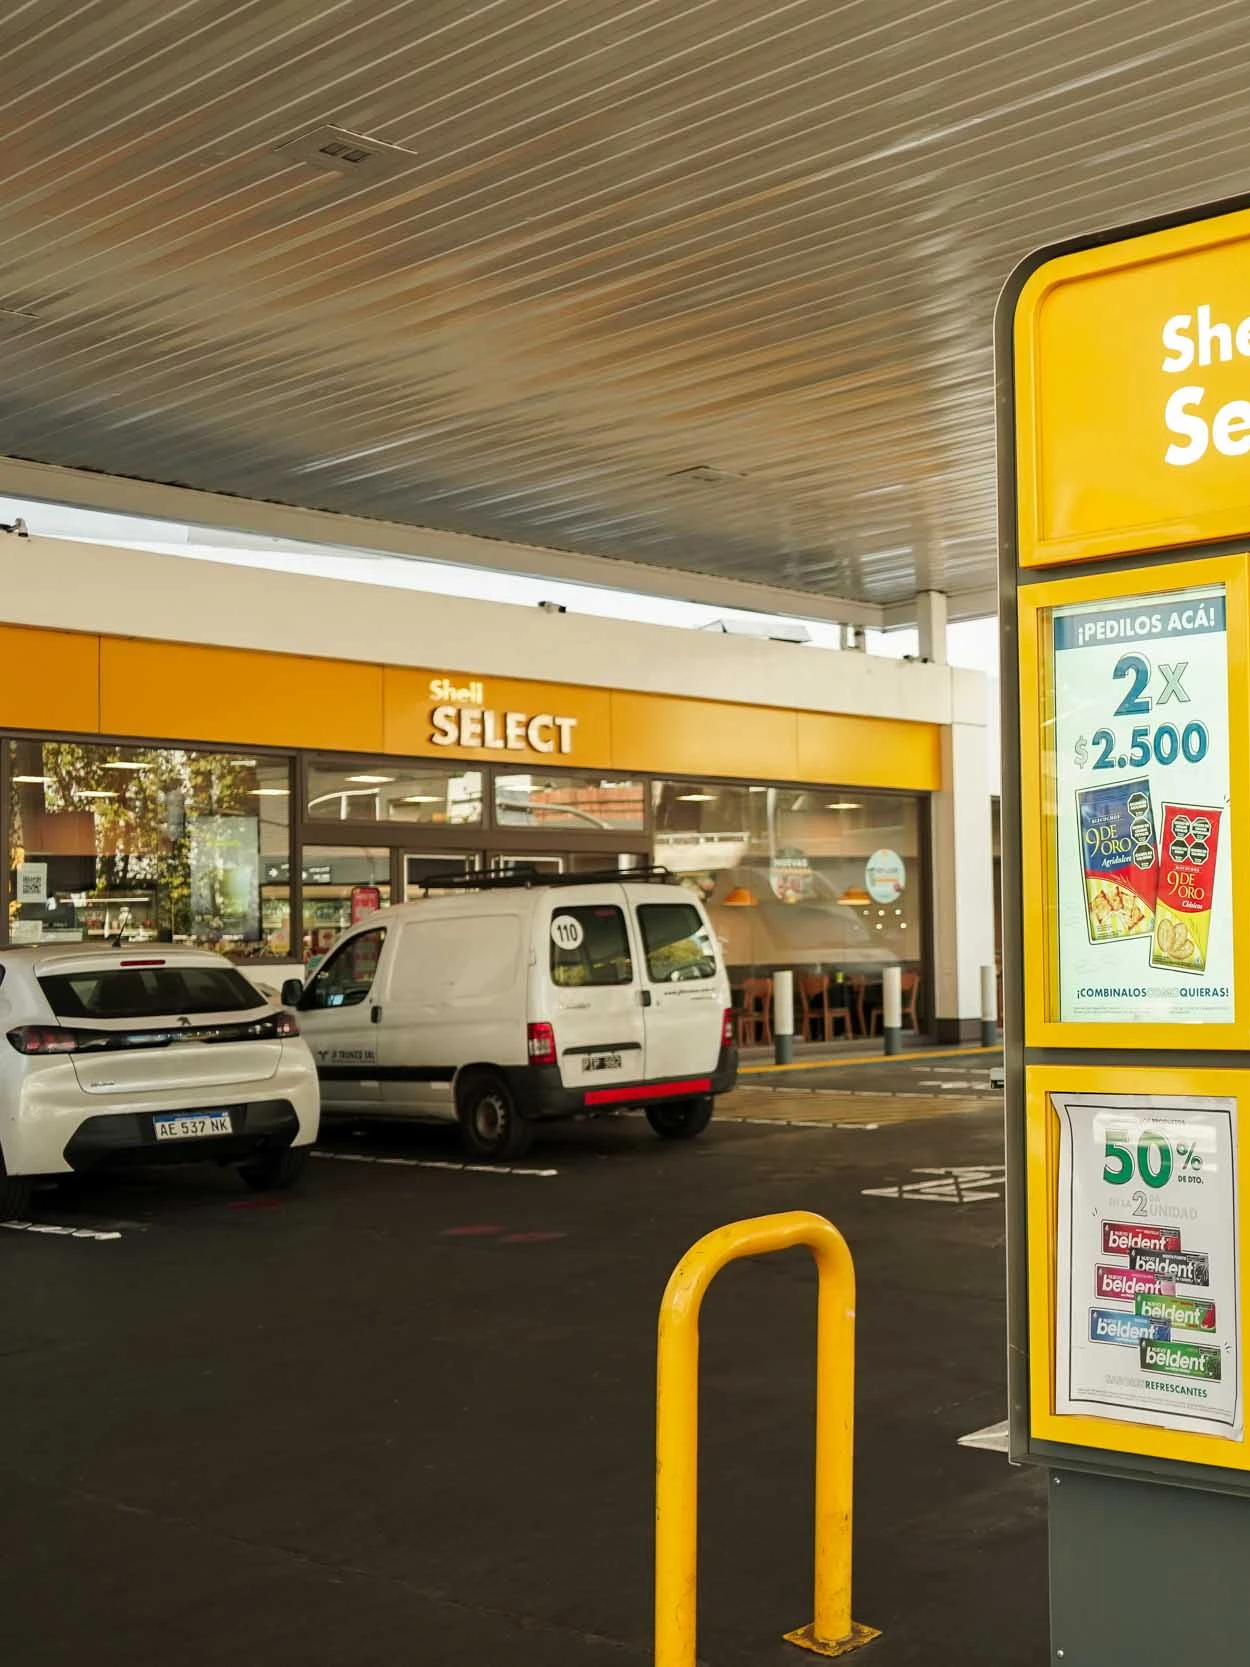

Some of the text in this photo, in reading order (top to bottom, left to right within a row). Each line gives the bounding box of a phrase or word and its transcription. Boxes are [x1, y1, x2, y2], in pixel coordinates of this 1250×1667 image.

[1078, 603, 1216, 646] ¡PEDILOS ACÁ!
[429, 678, 483, 705] Shell
[1112, 651, 1153, 717] 2
[430, 704, 578, 754] SELECT
[1074, 719, 1209, 771] $2.500
[1085, 827, 1099, 857] 9
[1101, 824, 1117, 843] DE
[1101, 838, 1132, 856] ORO
[1167, 870, 1180, 896] 9
[1180, 874, 1195, 886] DE
[1178, 886, 1205, 901] ORO
[557, 923, 578, 943] 110
[1076, 987, 1147, 1000] ¡COMBINALOS
[1179, 987, 1230, 998] QUIERAS!
[160, 1118, 229, 1137] AE 537 NK
[1177, 1175, 1187, 1184] DE
[1132, 1190, 1149, 1217] 2
[1108, 1231, 1167, 1251] beldent
[1135, 1255, 1194, 1279] beldent
[1102, 1273, 1162, 1295] beldent
[1141, 1301, 1201, 1325] beldent
[1096, 1318, 1156, 1338] beldent
[1145, 1347, 1207, 1372] beldent
[1145, 1379, 1208, 1398] REFRESCANTES
